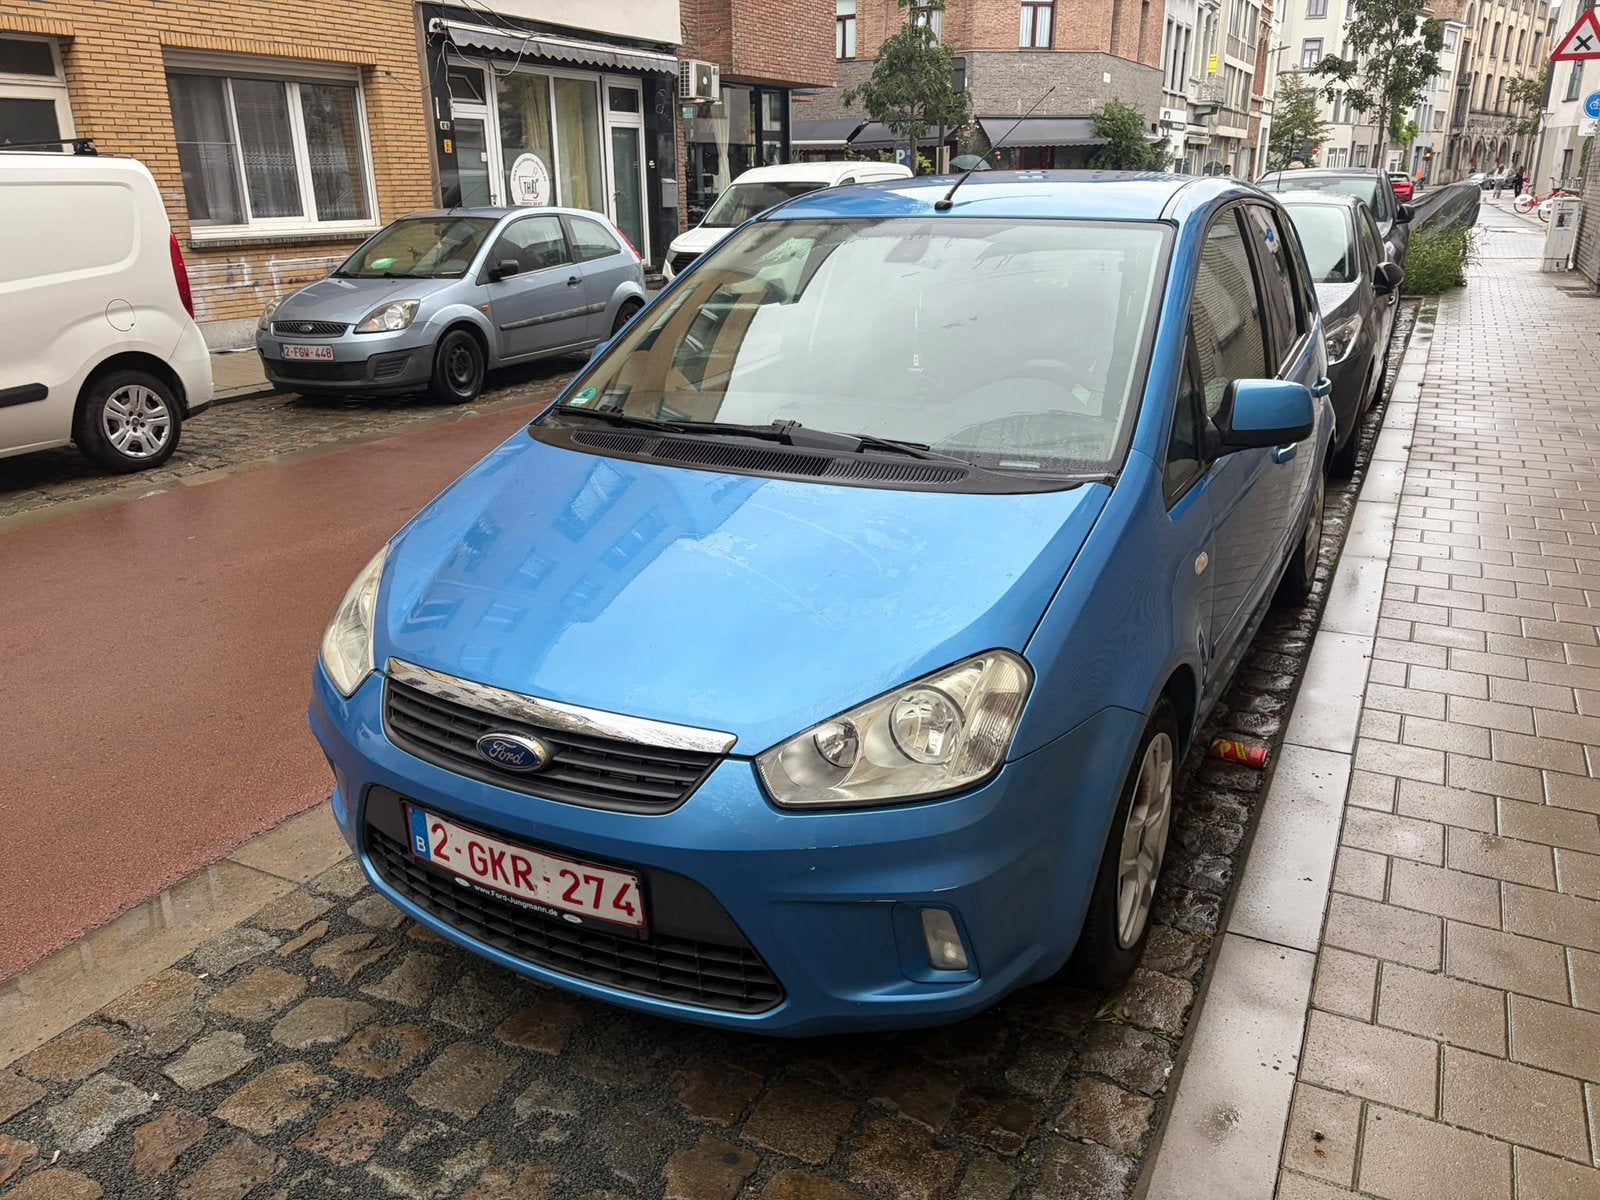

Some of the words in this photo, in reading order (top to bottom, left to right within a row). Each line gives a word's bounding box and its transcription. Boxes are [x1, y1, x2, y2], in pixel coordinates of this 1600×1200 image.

[896, 149, 906, 164] P
[285, 346, 332, 358] 2-FGW-448
[489, 740, 525, 765] Ford
[415, 835, 427, 852] B
[431, 823, 636, 917] 2-GKR-274
[473, 885, 559, 917] www.Ford-Jungmann.de
